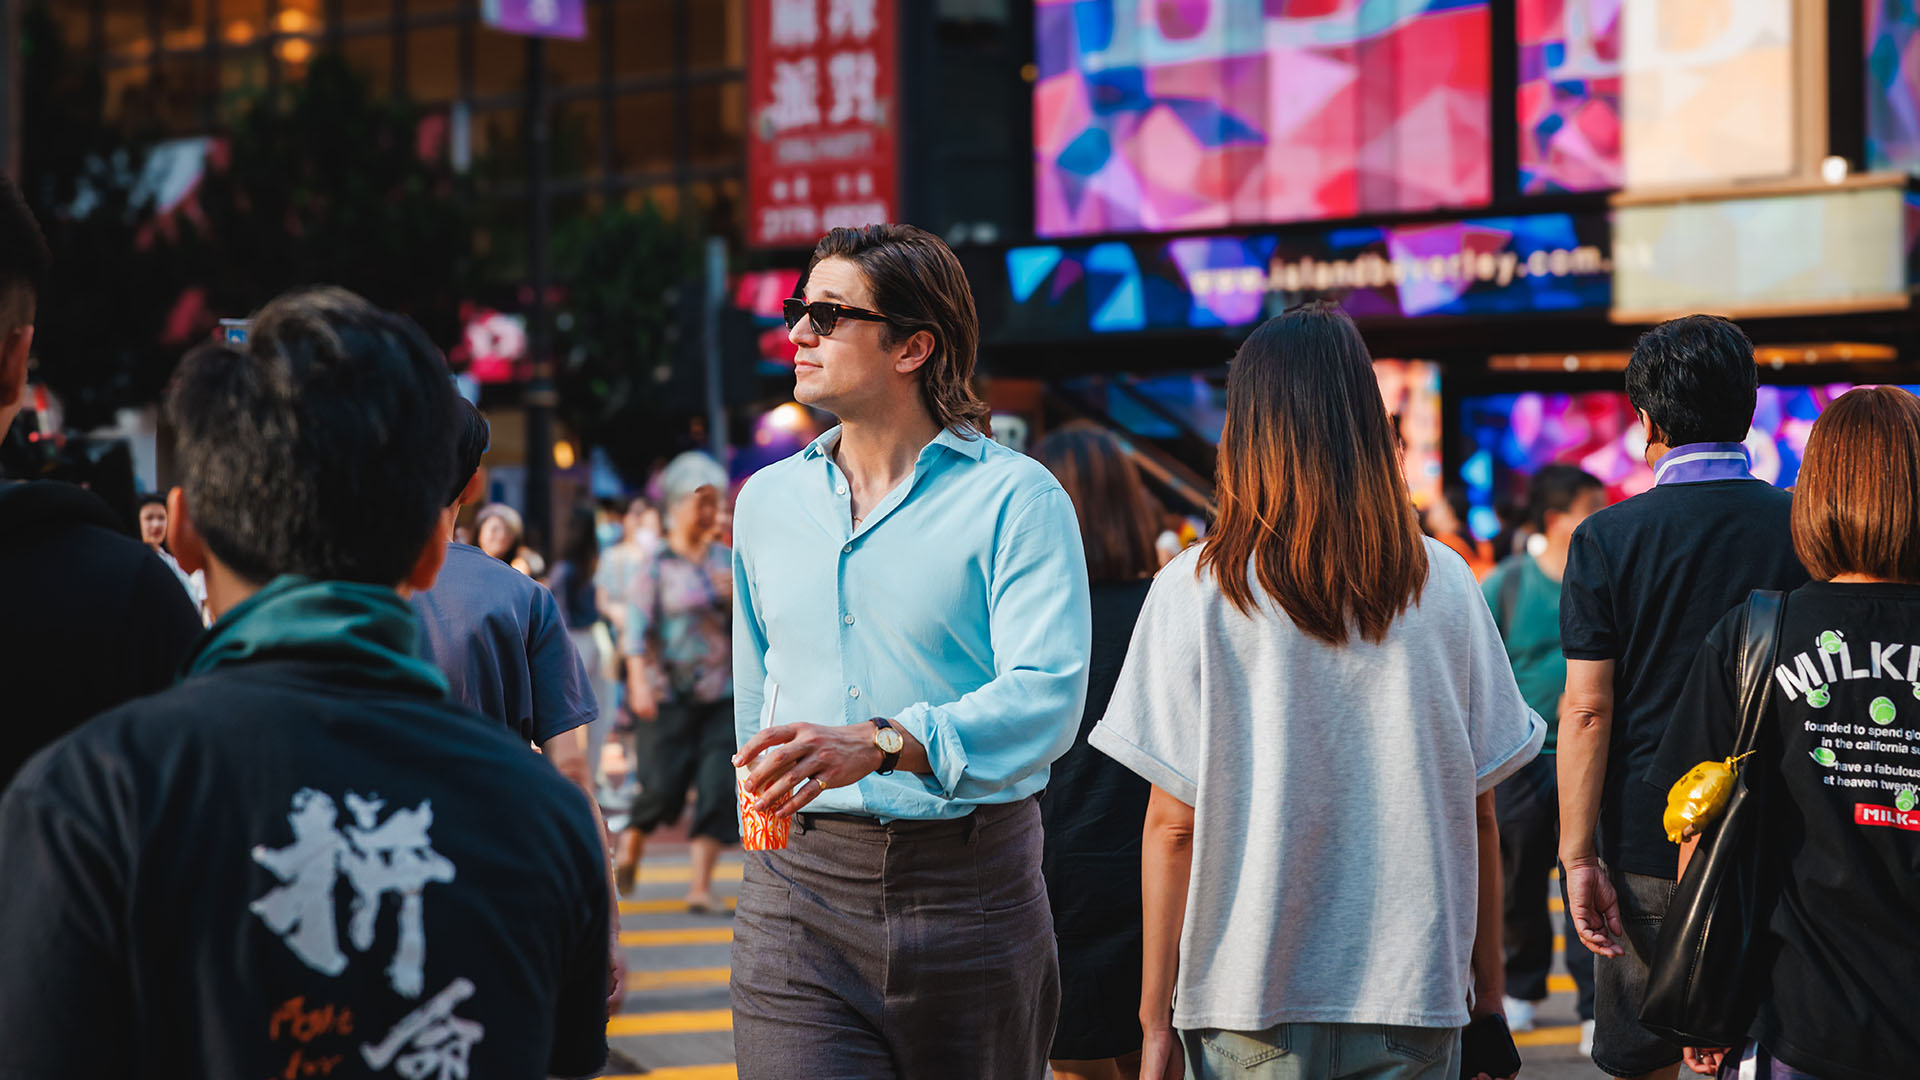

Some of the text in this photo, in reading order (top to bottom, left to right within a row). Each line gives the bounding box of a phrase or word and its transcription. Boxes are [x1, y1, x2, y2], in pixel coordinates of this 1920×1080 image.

[1804, 720, 1851, 734] founded
[1853, 724, 1866, 735] to
[1868, 725, 1903, 739] spend
[1821, 736, 1833, 748] in
[1835, 738, 1854, 750] the
[1855, 740, 1909, 755] california
[1834, 760, 1862, 773] have
[1864, 764, 1872, 773] a
[1823, 775, 1835, 786] at
[1837, 775, 1879, 788] heaven
